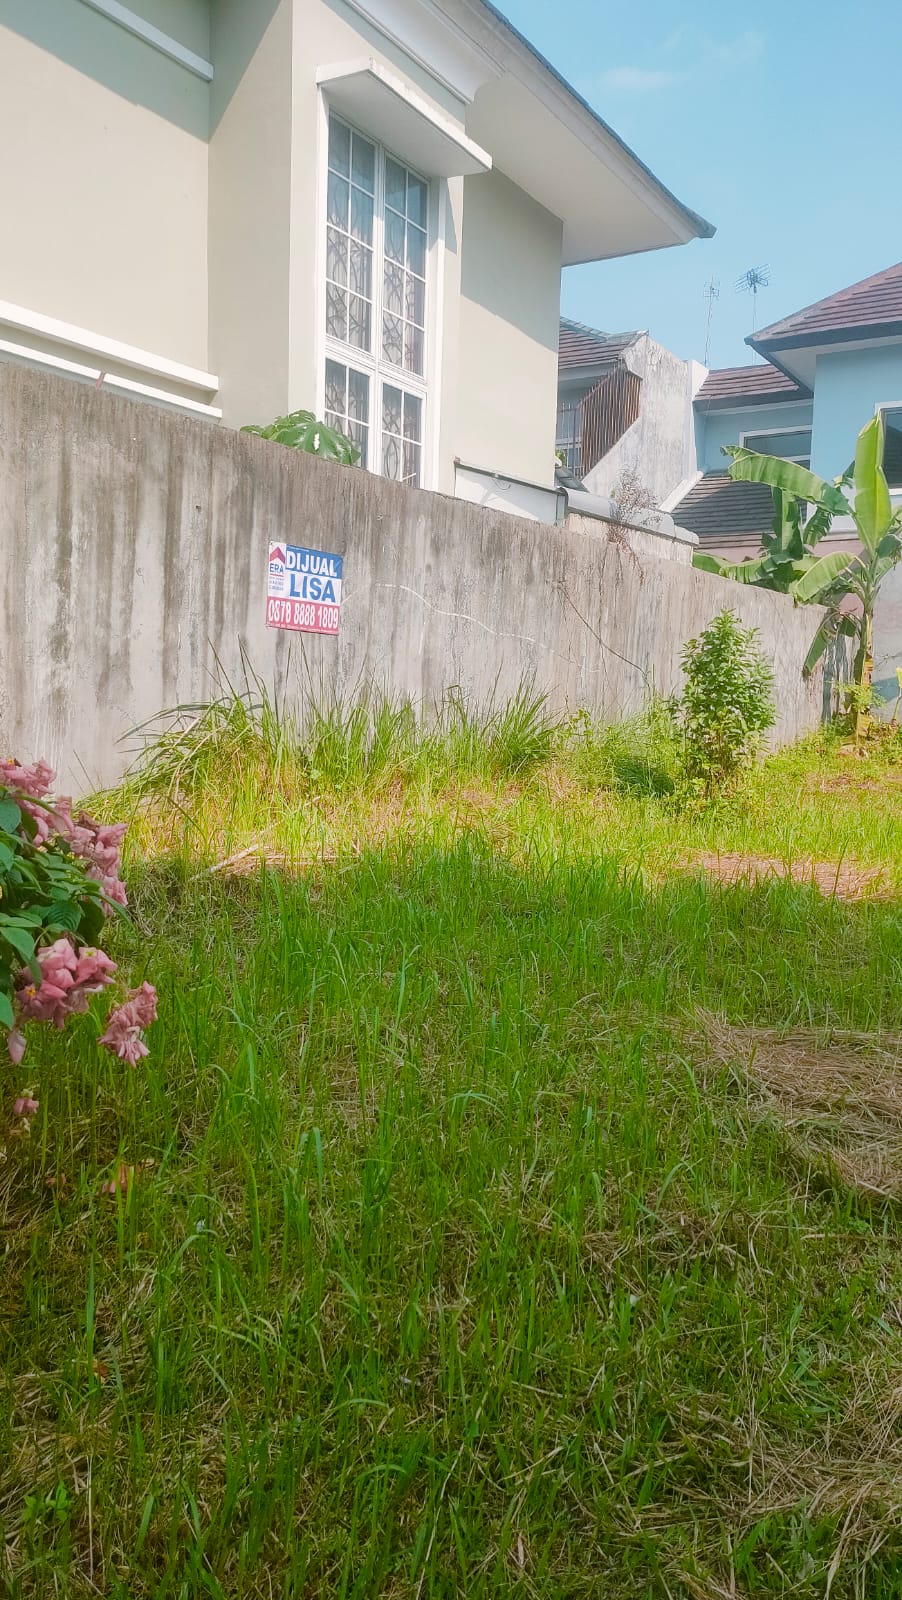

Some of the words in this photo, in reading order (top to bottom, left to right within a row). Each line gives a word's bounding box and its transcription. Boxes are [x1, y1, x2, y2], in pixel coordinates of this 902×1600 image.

[269, 563, 284, 574] ERA
[286, 551, 337, 577] DIJUAL
[289, 574, 336, 603] LISA
[268, 600, 291, 623] 0878
[293, 603, 315, 626] 8888
[318, 606, 339, 628] 1809
